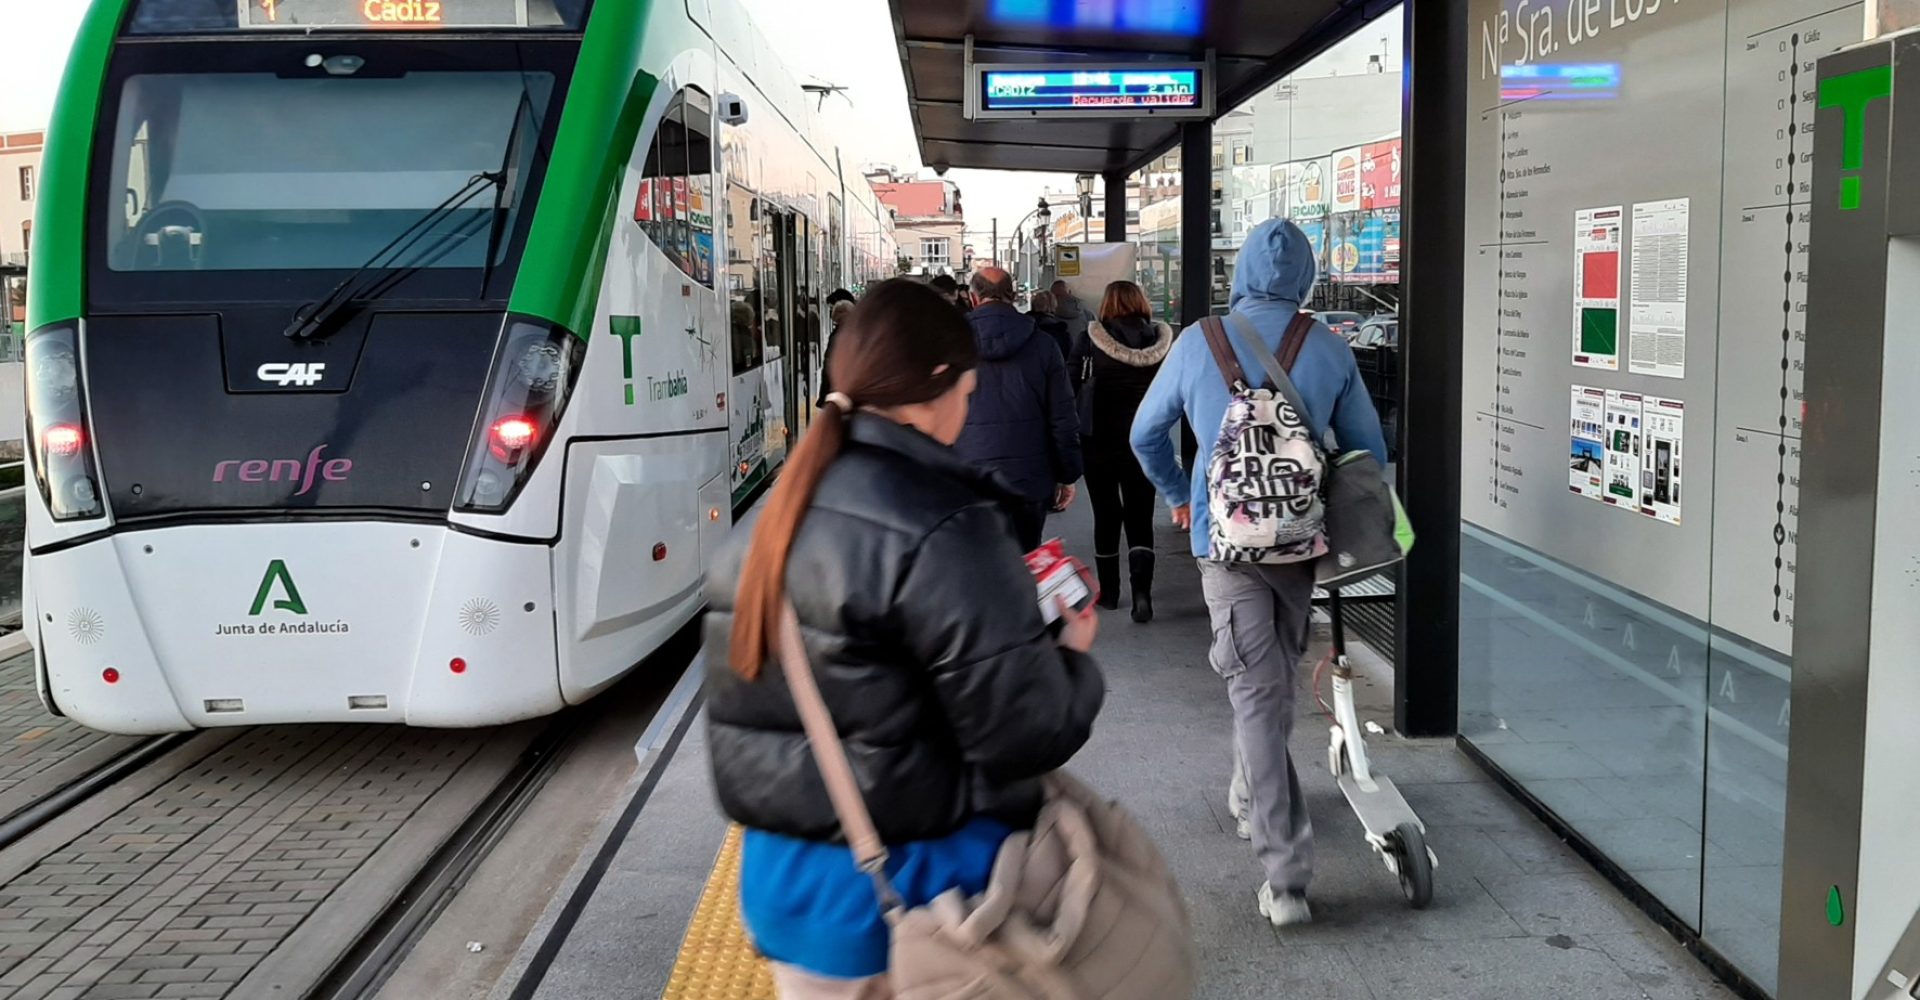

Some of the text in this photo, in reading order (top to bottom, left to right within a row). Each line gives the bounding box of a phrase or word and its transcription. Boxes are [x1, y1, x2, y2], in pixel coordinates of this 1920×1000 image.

[1515, 0, 1559, 66] Sra.
[1567, 0, 1600, 45] de
[1803, 28, 1821, 44] Cádiz
[1803, 62, 1815, 73] San
[1149, 84, 1157, 93] 2
[1165, 84, 1189, 93] min
[1072, 94, 1194, 105] Recuerde validar
[1799, 181, 1810, 193] Río
[1794, 330, 1806, 342] Pla
[1793, 360, 1804, 371] Pla
[257, 363, 325, 386] CAF
[212, 444, 352, 496] renfe
[1787, 561, 1796, 574] Re
[215, 619, 349, 635] Junta de Andalucía
[1785, 614, 1794, 627] Pe
